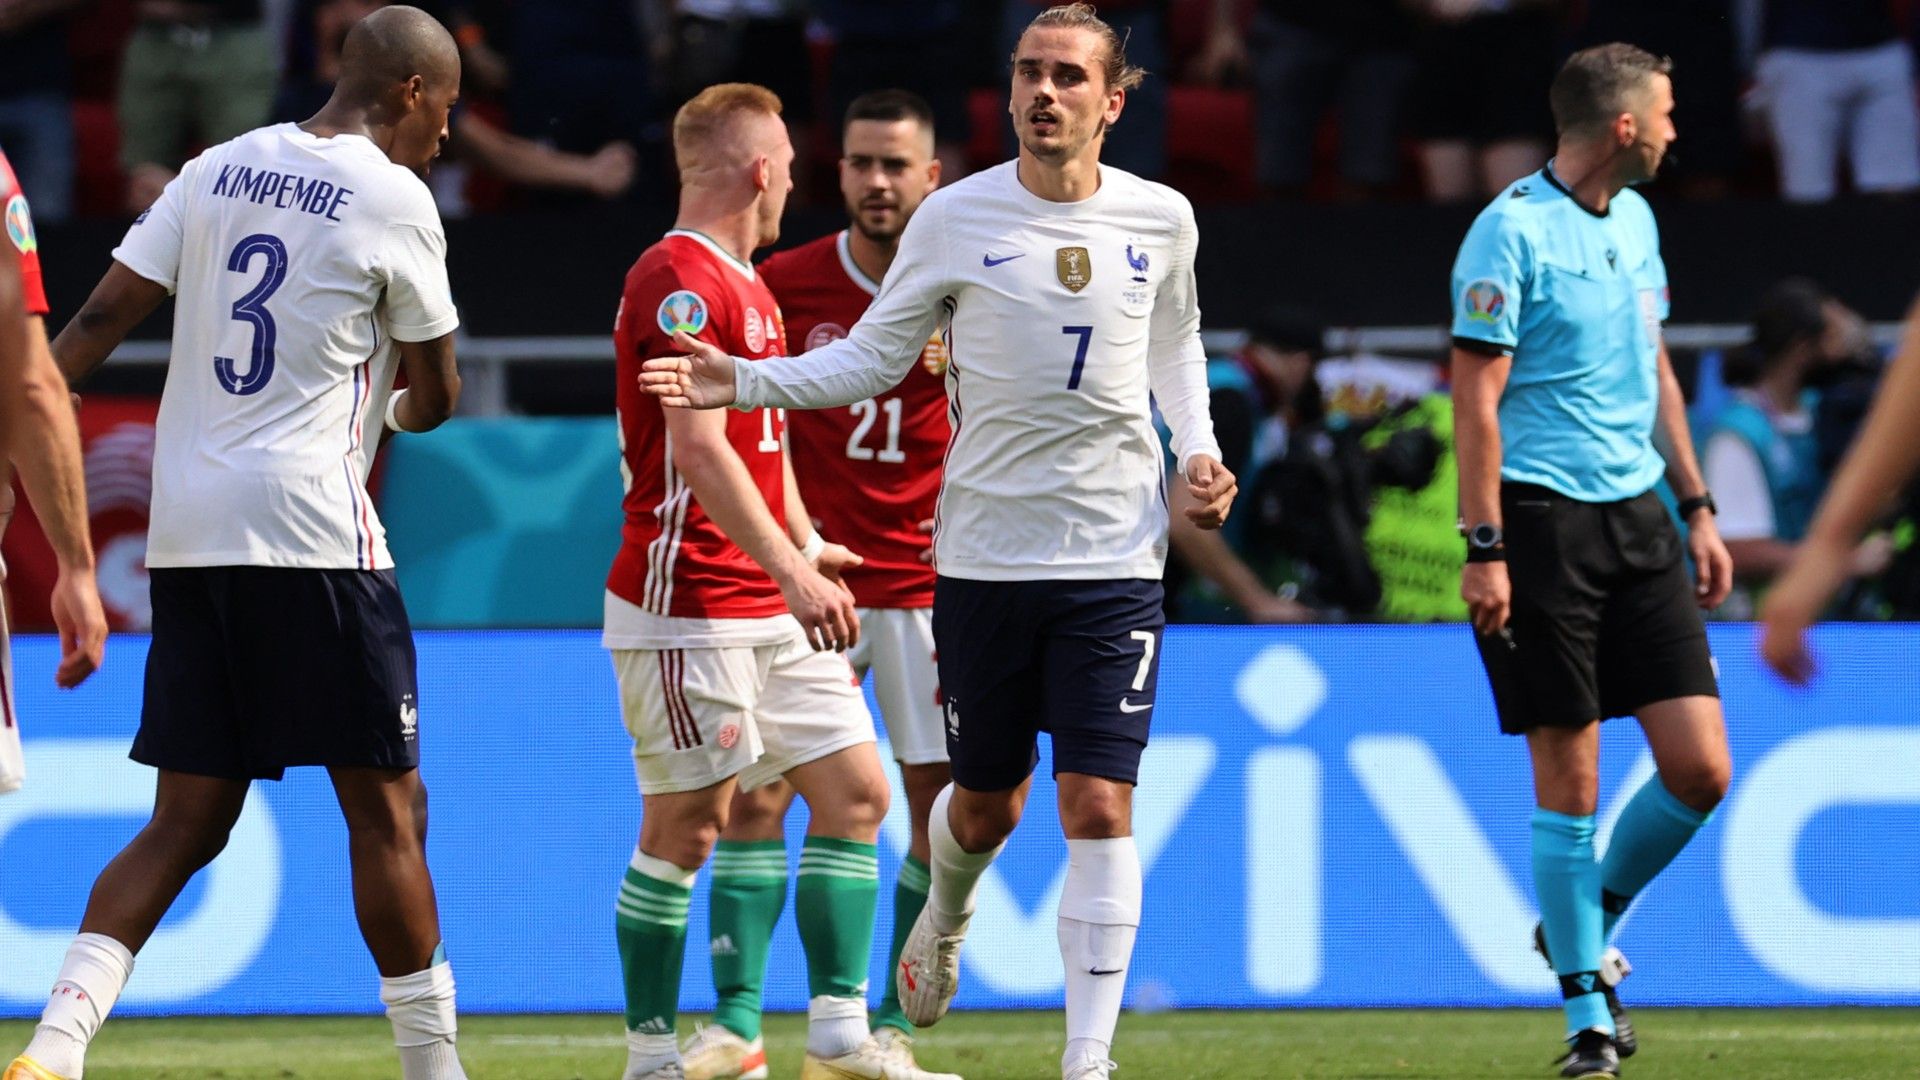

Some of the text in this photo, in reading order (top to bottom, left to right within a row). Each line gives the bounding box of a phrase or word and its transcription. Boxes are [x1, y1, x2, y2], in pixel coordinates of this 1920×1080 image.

[212, 164, 354, 222] KIMPEMBE
[213, 233, 289, 396] 3
[1062, 325, 1094, 391] 7
[846, 397, 906, 464] 21
[1130, 629, 1155, 692] 7
